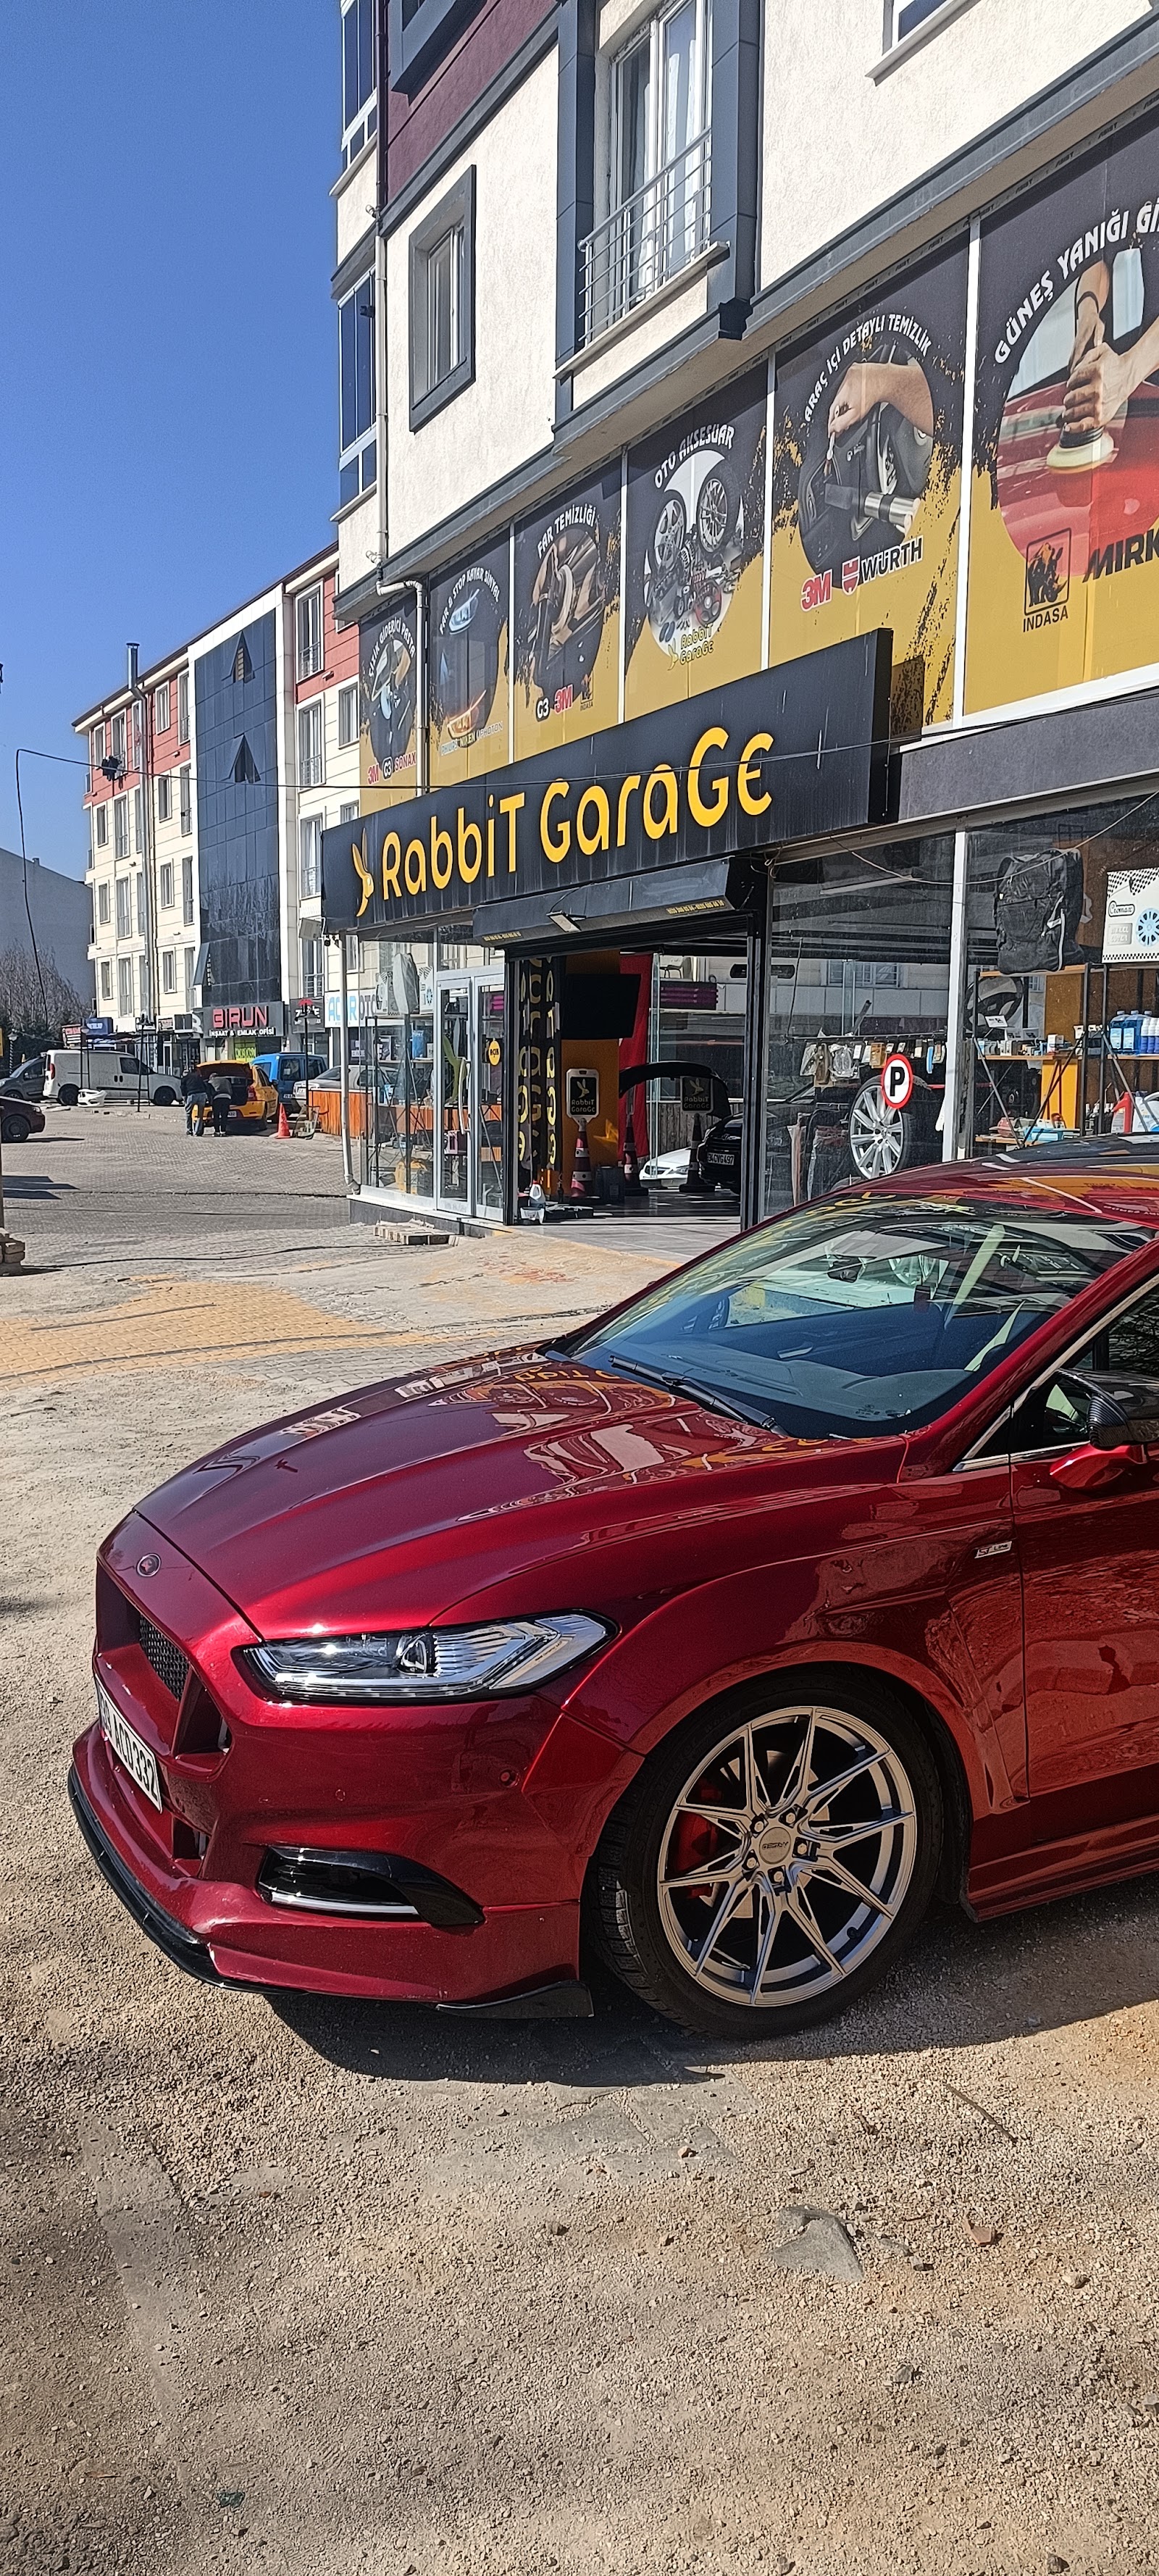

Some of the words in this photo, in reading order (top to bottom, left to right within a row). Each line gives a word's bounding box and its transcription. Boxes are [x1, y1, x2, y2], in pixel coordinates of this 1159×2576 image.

[995, 270, 1054, 363] GÜNEŞ
[1057, 209, 1129, 280] YANIĞI
[804, 371, 829, 422] ARAÇ
[826, 346, 841, 374] İÇİ
[842, 314, 886, 356] DETAYLI
[888, 314, 932, 357] TEMİZLİK
[654, 451, 676, 488] OTO
[679, 423, 735, 461] AKSESUAR
[537, 526, 553, 559] FAR
[554, 503, 596, 535] TEMİZLİĞİ
[439, 606, 449, 635] FAR
[452, 574, 466, 599] STOP
[466, 566, 484, 582] KAYAR
[484, 569, 500, 603] SİNYAL
[801, 570, 832, 611] 3M
[861, 536, 924, 583] WÜRTH
[401, 622, 416, 658] PASTA
[1023, 605, 1068, 632] INDASA
[554, 684, 573, 715] 3M
[367, 764, 379, 785] 3M
[394, 751, 417, 771] SONAX
[328, 996, 358, 1021] ACR
[890, 1066, 905, 1097] P
[113, 1713, 134, 1771] ACD
[133, 1740, 158, 1802] 332
